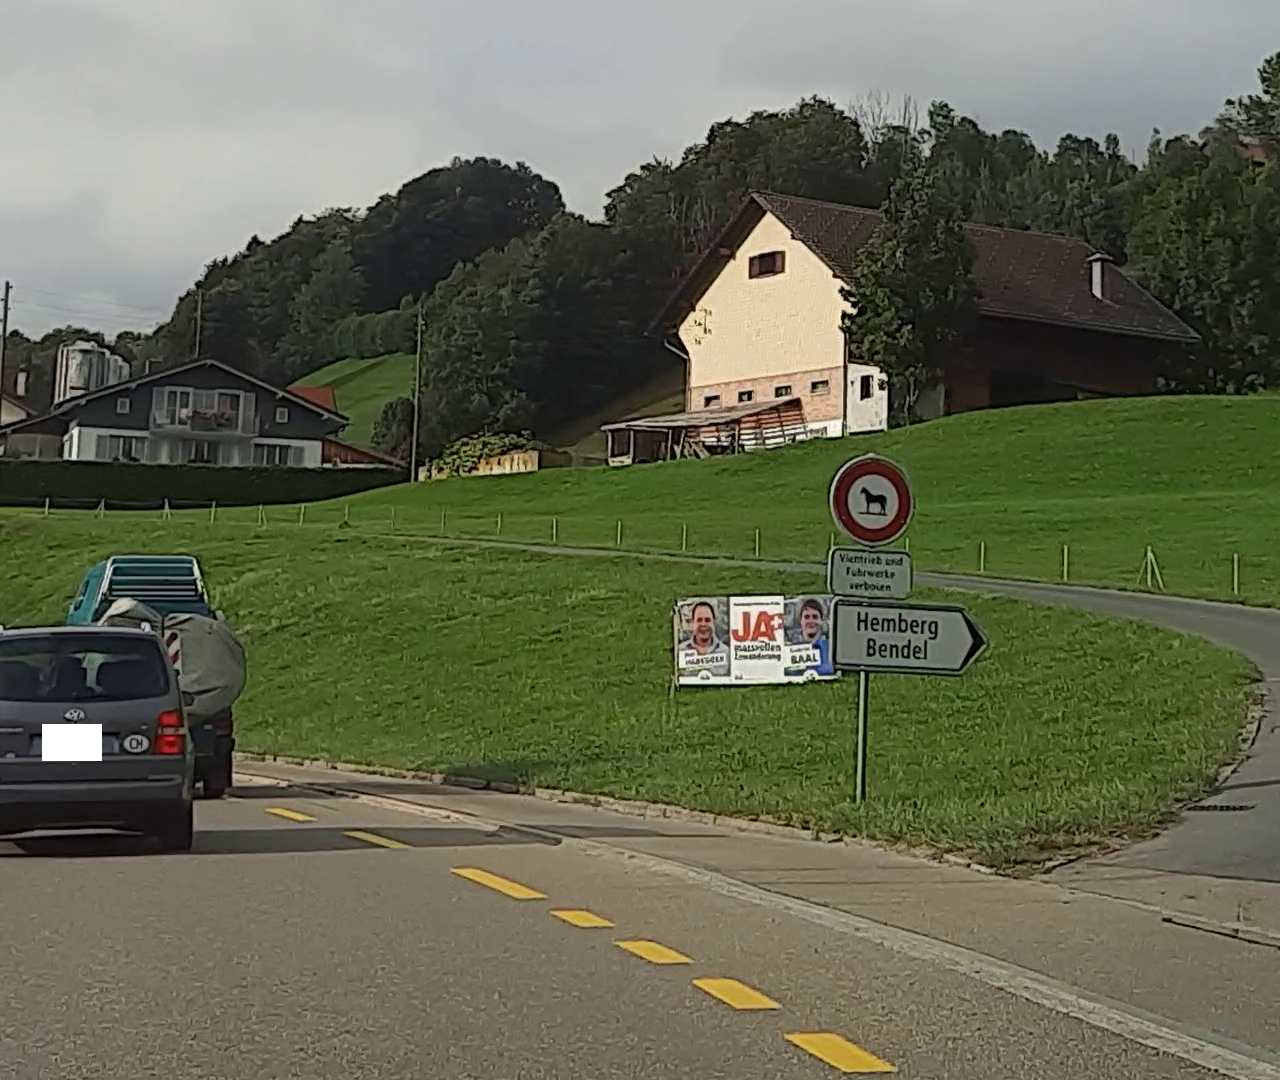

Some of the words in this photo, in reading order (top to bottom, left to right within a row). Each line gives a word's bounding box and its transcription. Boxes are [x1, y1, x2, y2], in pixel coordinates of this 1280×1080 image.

[731, 611, 777, 642] JA
[856, 611, 939, 641] Hemberg
[866, 637, 928, 660] Bendel
[129, 737, 143, 750] CH
